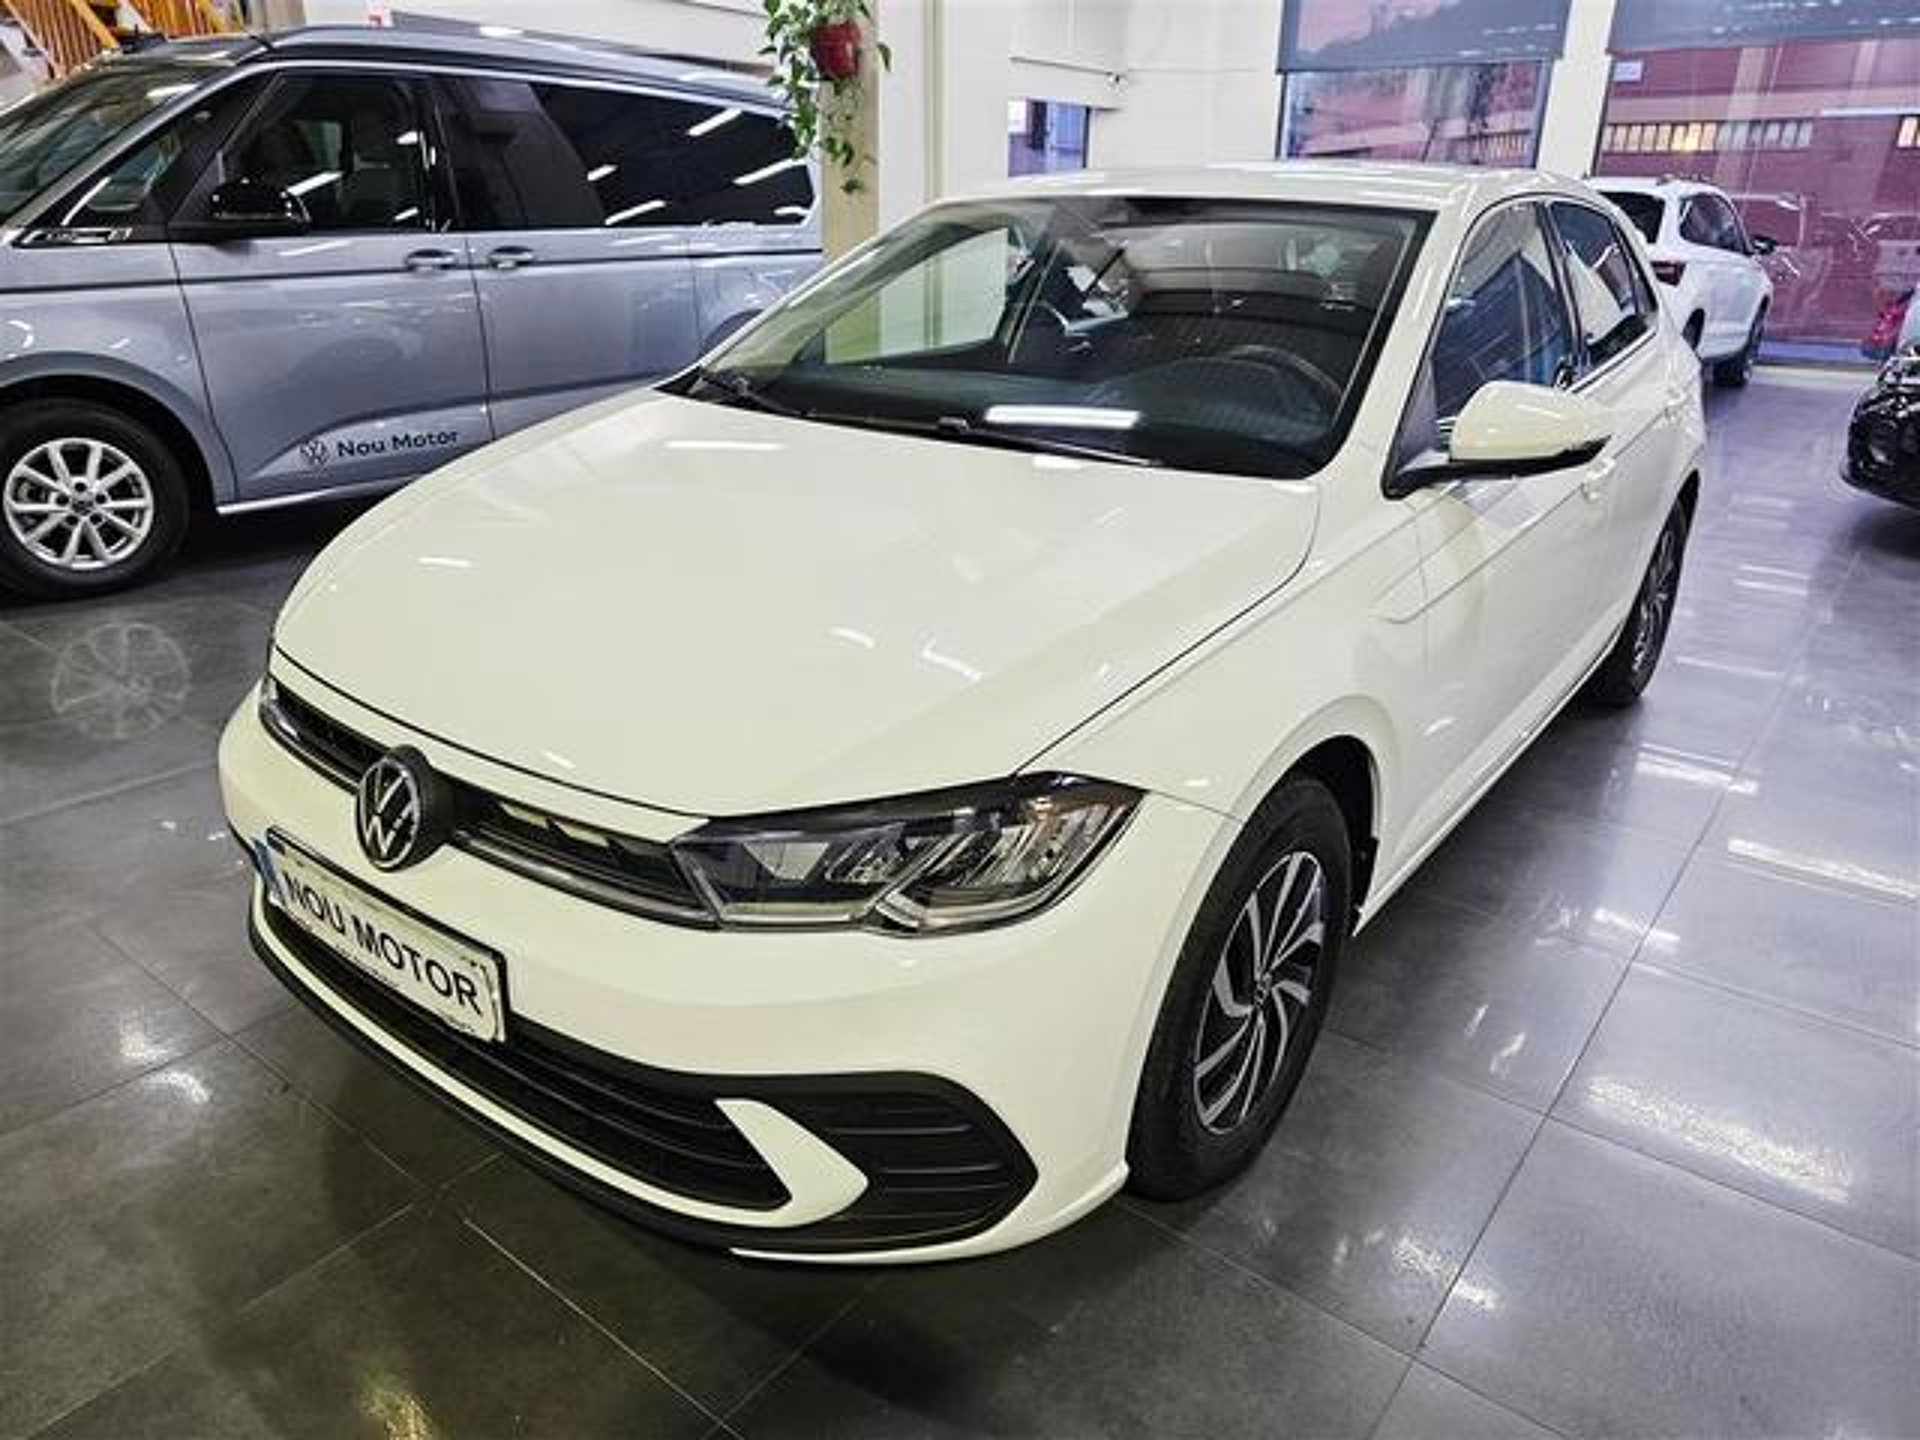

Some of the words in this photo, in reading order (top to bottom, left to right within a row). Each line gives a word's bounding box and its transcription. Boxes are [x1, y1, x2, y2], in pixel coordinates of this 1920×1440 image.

[337, 441, 385, 457] Nou
[392, 431, 457, 450] Motor
[282, 870, 346, 936] NOU
[351, 914, 483, 1017] MOTOR
